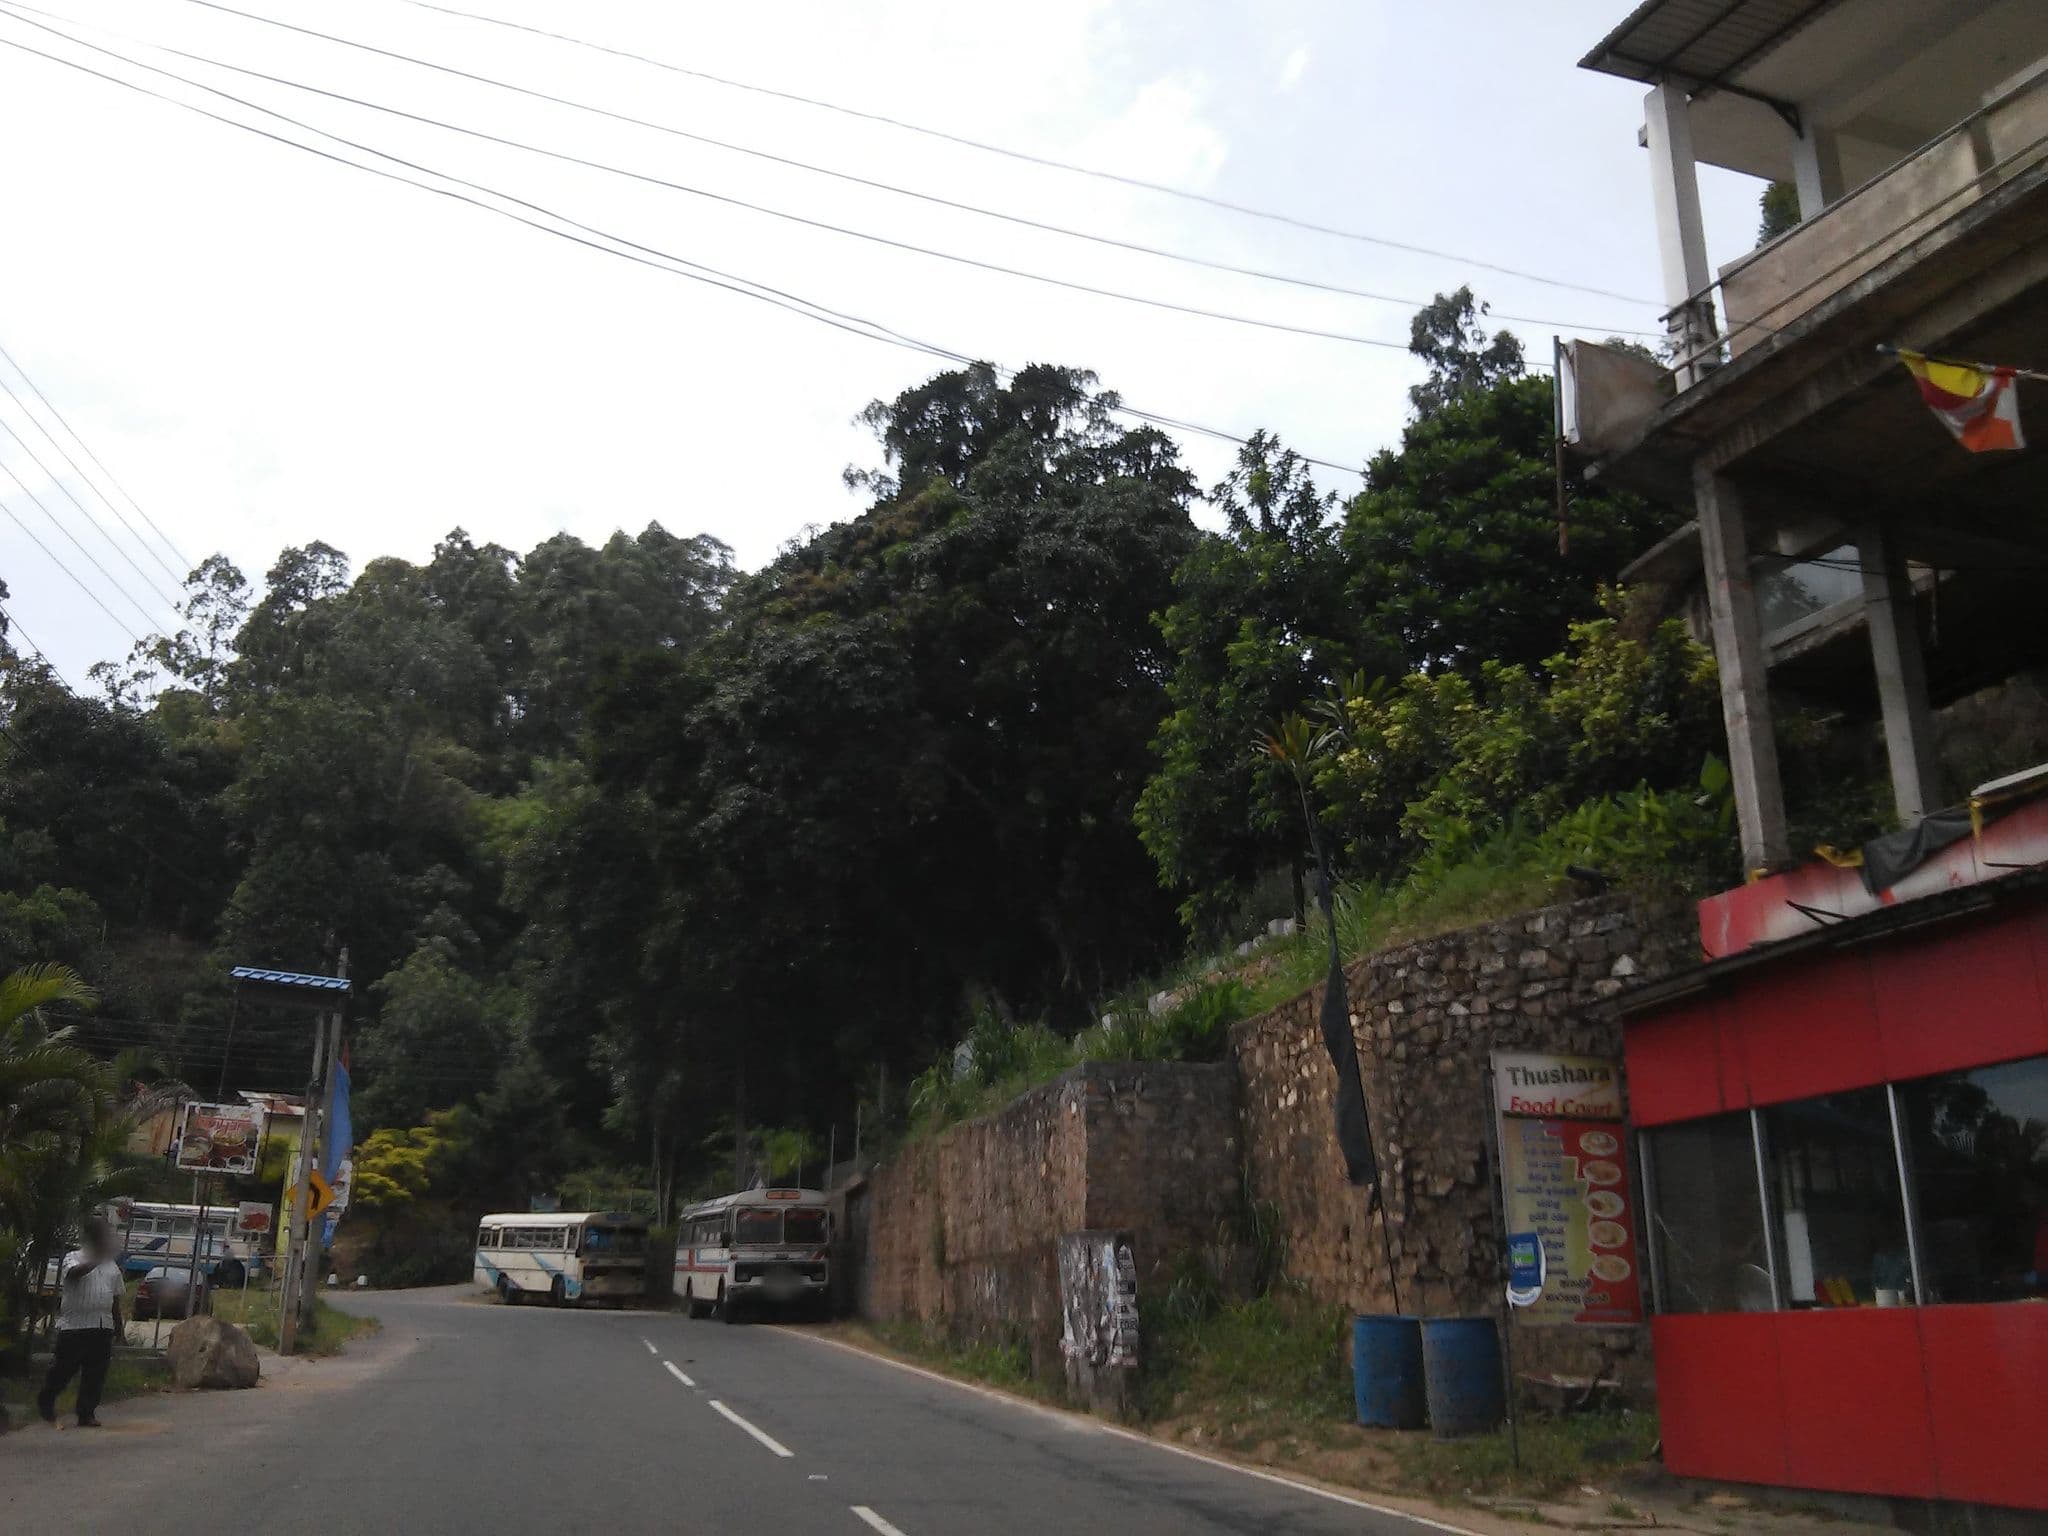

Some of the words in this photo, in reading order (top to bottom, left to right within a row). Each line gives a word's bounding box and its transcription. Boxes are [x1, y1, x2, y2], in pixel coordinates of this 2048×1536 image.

[1505, 1064, 1611, 1086] Thushara
[1510, 1096, 1555, 1113] Food
[1562, 1098, 1612, 1115] Court
